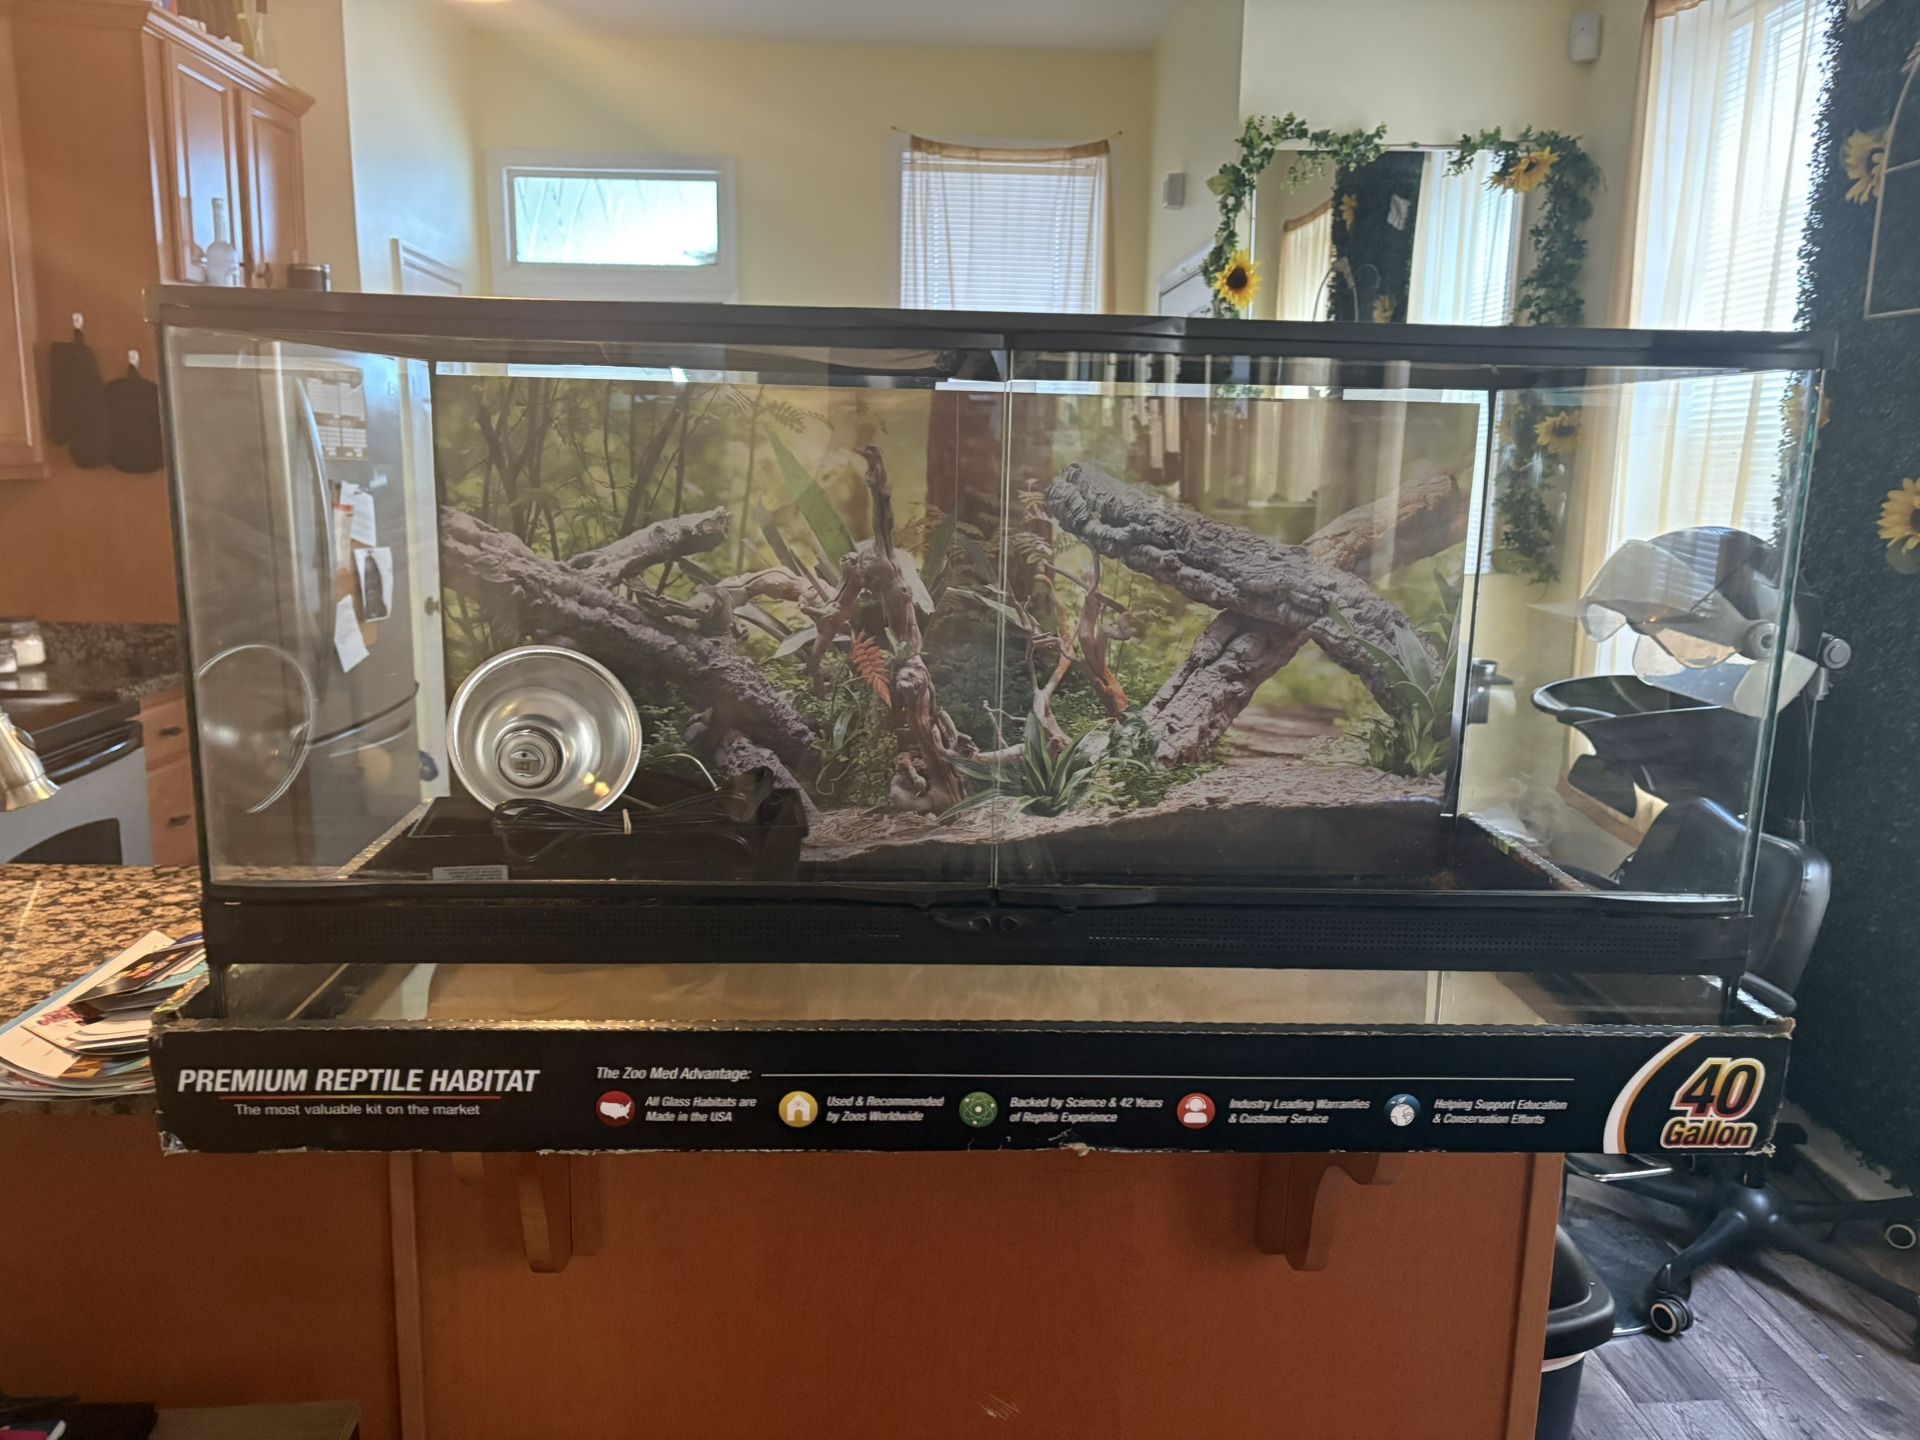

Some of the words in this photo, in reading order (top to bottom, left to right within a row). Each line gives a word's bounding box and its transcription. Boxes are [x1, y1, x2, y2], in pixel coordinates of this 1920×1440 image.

[596, 1067, 619, 1080] The
[623, 1067, 646, 1080] Zoo
[650, 1067, 678, 1080] Med
[680, 1067, 751, 1082] Advantage:
[177, 1069, 307, 1093] PREMIUM
[314, 1069, 423, 1093] REPTILE
[429, 1069, 540, 1093] HABITAT
[1672, 1058, 1764, 1118] 40
[645, 1096, 660, 1107] All
[662, 1096, 690, 1107] Glass
[693, 1096, 737, 1107] Habitats
[739, 1098, 757, 1107] are
[826, 1096, 854, 1107] Used
[855, 1096, 864, 1106] &
[866, 1096, 945, 1107] Recommended
[1009, 1097, 1049, 1108] Backed
[1050, 1097, 1063, 1109] by
[1065, 1097, 1106, 1108] Science
[1108, 1097, 1117, 1107] &
[1119, 1098, 1134, 1108] 42
[1135, 1097, 1164, 1108] Years
[1229, 1098, 1272, 1111] Industry
[1273, 1099, 1315, 1111] Leading
[1316, 1099, 1371, 1109] Warranties
[1434, 1099, 1473, 1111] Helping
[1474, 1099, 1516, 1112] Support
[1517, 1100, 1568, 1110] Education
[234, 1104, 261, 1115] The
[265, 1105, 300, 1115] most
[304, 1103, 362, 1115] valuable
[365, 1103, 383, 1115] kit
[386, 1106, 404, 1115] on
[408, 1104, 430, 1115] the
[433, 1103, 480, 1115] market
[645, 1111, 676, 1122] Made
[677, 1111, 689, 1122] in
[690, 1111, 708, 1122] the
[709, 1111, 733, 1122] USA
[826, 1111, 840, 1124] by
[841, 1111, 867, 1121] Zoos
[1009, 1112, 1021, 1122] of
[1022, 1112, 1059, 1124] Reptile
[1060, 1112, 1118, 1124] Experience
[1228, 1113, 1238, 1124] &
[1240, 1113, 1289, 1124] Customer
[1290, 1113, 1329, 1124] Service
[1432, 1113, 1441, 1124] &
[1443, 1113, 1510, 1124] Conservation
[1511, 1114, 1545, 1124] Efforts
[1662, 1119, 1756, 1147] Gallon
